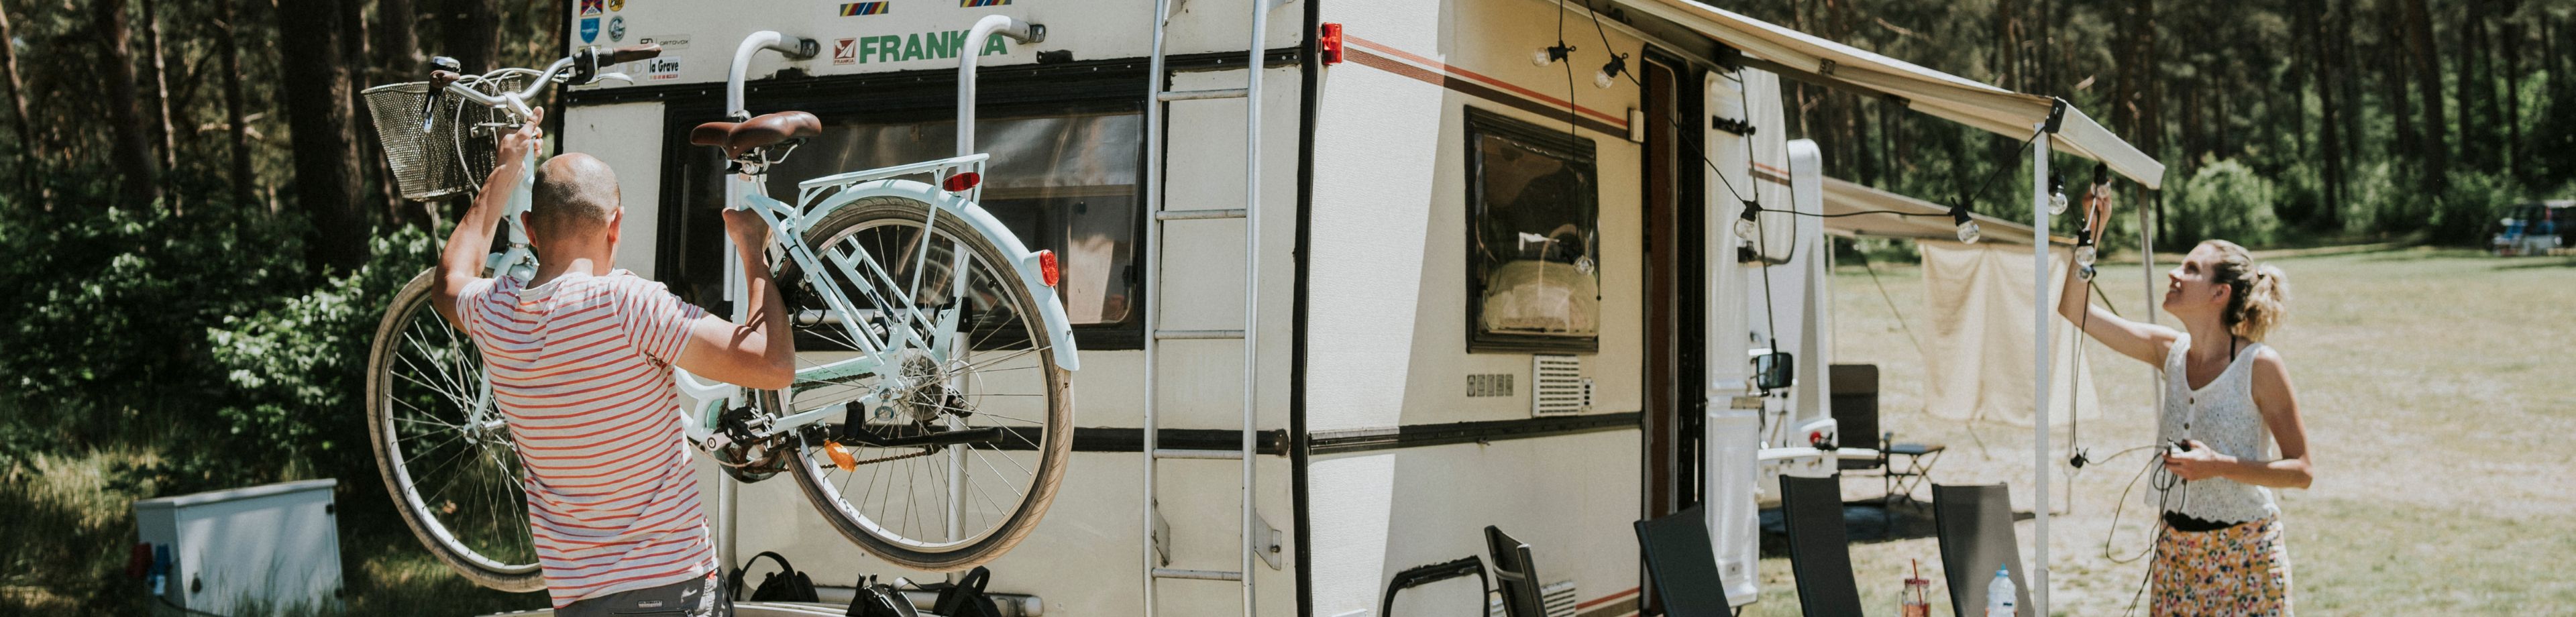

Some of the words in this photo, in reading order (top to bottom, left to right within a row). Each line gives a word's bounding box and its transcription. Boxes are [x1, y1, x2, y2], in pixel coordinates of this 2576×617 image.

[859, 30, 1008, 64] FRANKA
[649, 59, 656, 73] la
[658, 59, 679, 72] Grave
